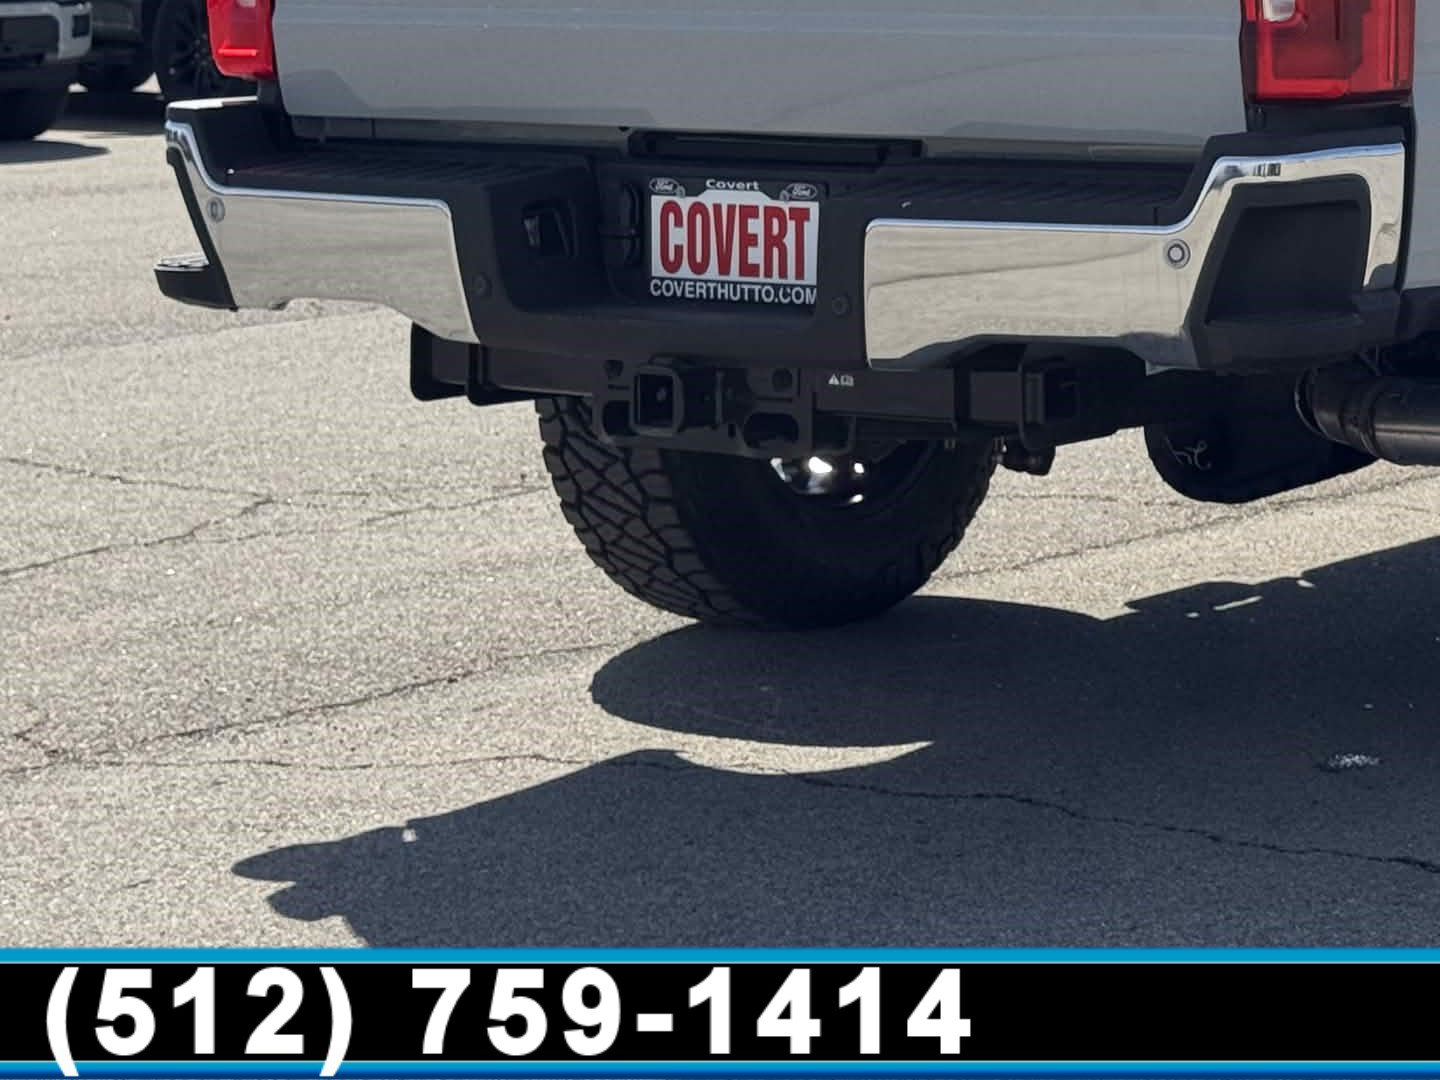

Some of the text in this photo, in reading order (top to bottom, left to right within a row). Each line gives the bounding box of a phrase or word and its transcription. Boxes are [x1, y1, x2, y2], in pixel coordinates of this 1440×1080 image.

[705, 178, 760, 191] Covert
[659, 199, 811, 281] COVERT
[649, 279, 817, 306] COVERTHUTTO.COM
